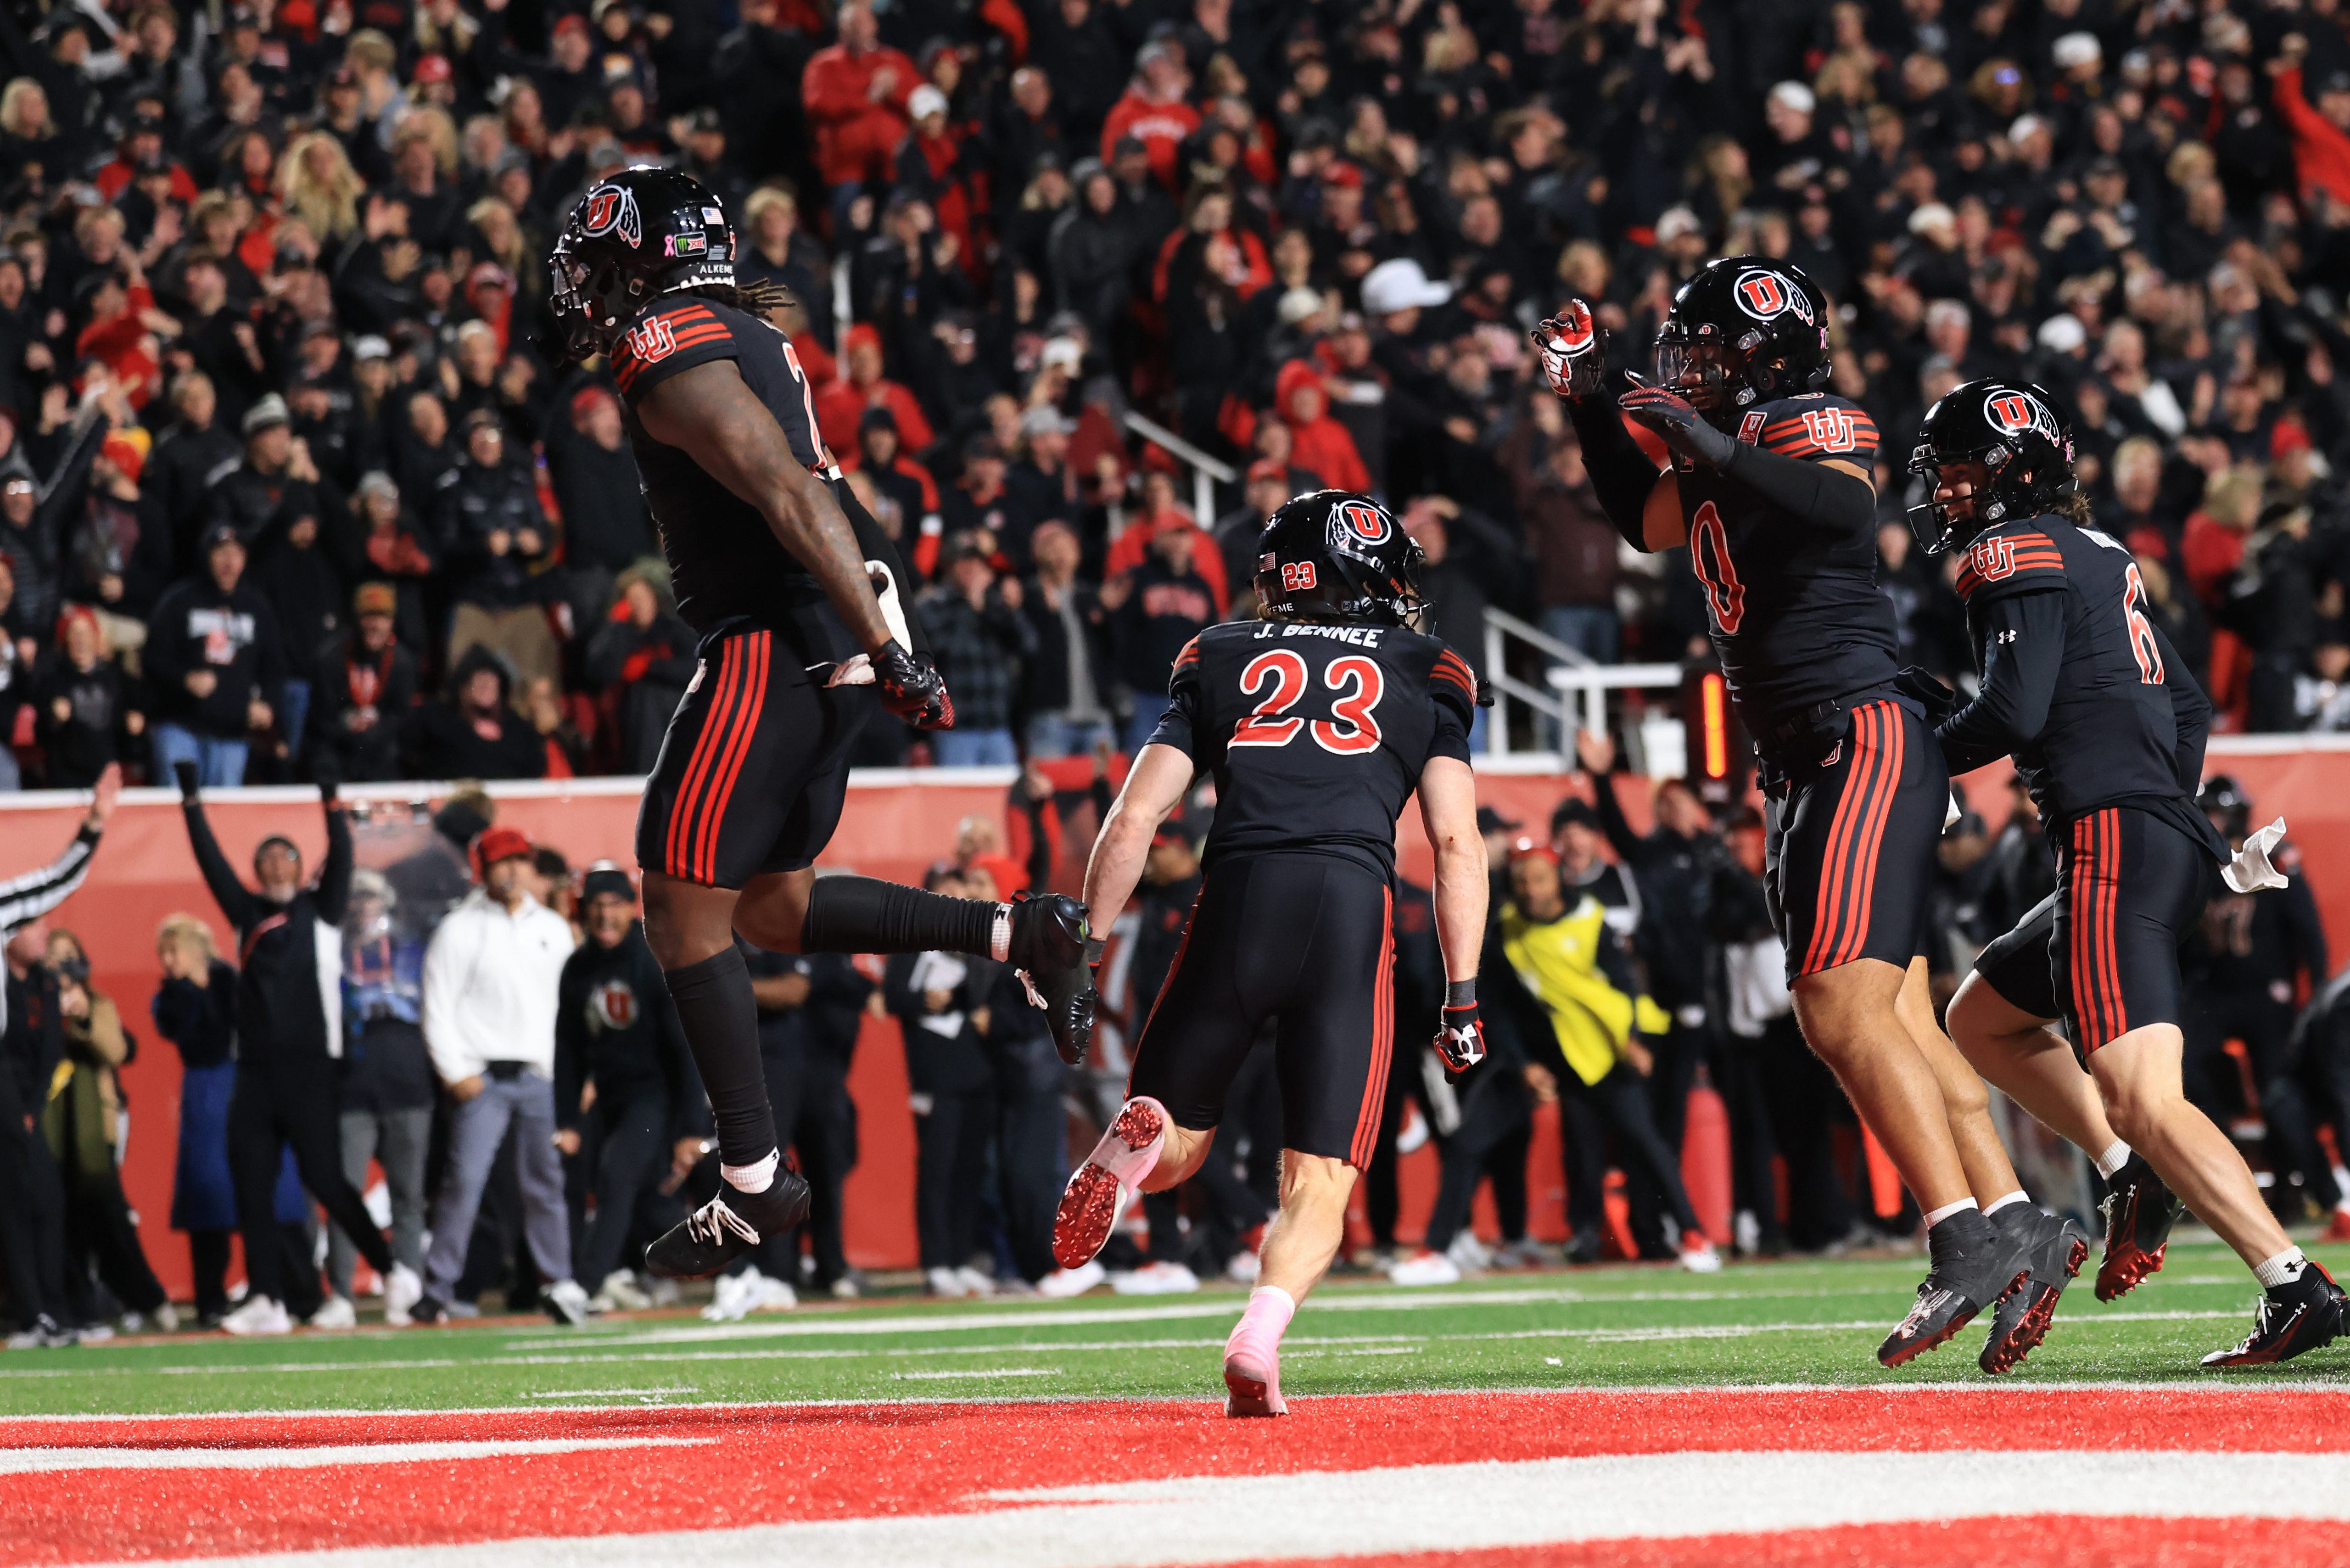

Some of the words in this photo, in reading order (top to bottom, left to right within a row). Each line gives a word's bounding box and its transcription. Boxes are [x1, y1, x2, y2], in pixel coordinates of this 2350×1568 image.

[1740, 277, 1784, 314] U
[1990, 396, 2031, 428] U
[1345, 506, 1384, 538] U
[1281, 561, 1317, 592] 23
[1690, 500, 1745, 635] 0
[1253, 623, 1274, 639] J.
[1282, 624, 1384, 649] BENNEE
[2123, 562, 2165, 684] 6
[1227, 648, 1384, 756] 23
